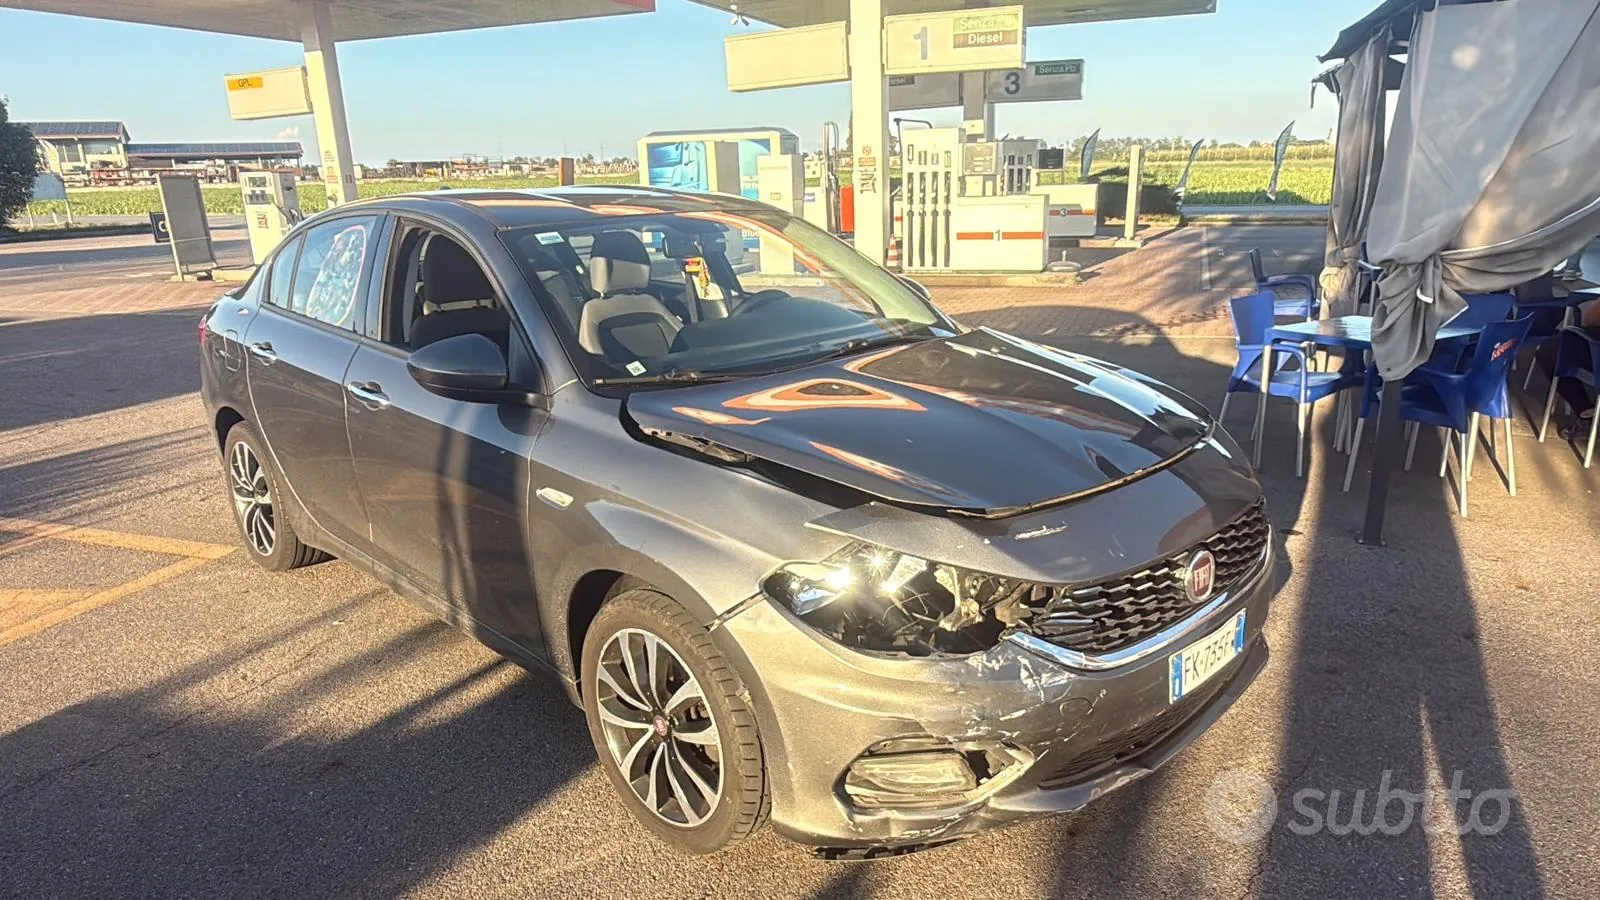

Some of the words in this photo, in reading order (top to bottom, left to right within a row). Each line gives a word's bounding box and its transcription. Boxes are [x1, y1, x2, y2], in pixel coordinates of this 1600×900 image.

[960, 16, 994, 30] Senza
[912, 26, 928, 60] 1
[967, 31, 1003, 45] Diesel
[1040, 63, 1064, 74] Senza
[238, 78, 252, 88] GPL
[1004, 71, 1020, 95] 3
[1060, 207, 1067, 217] 3
[995, 229, 1001, 242] 1
[1193, 562, 1210, 592] FIAT
